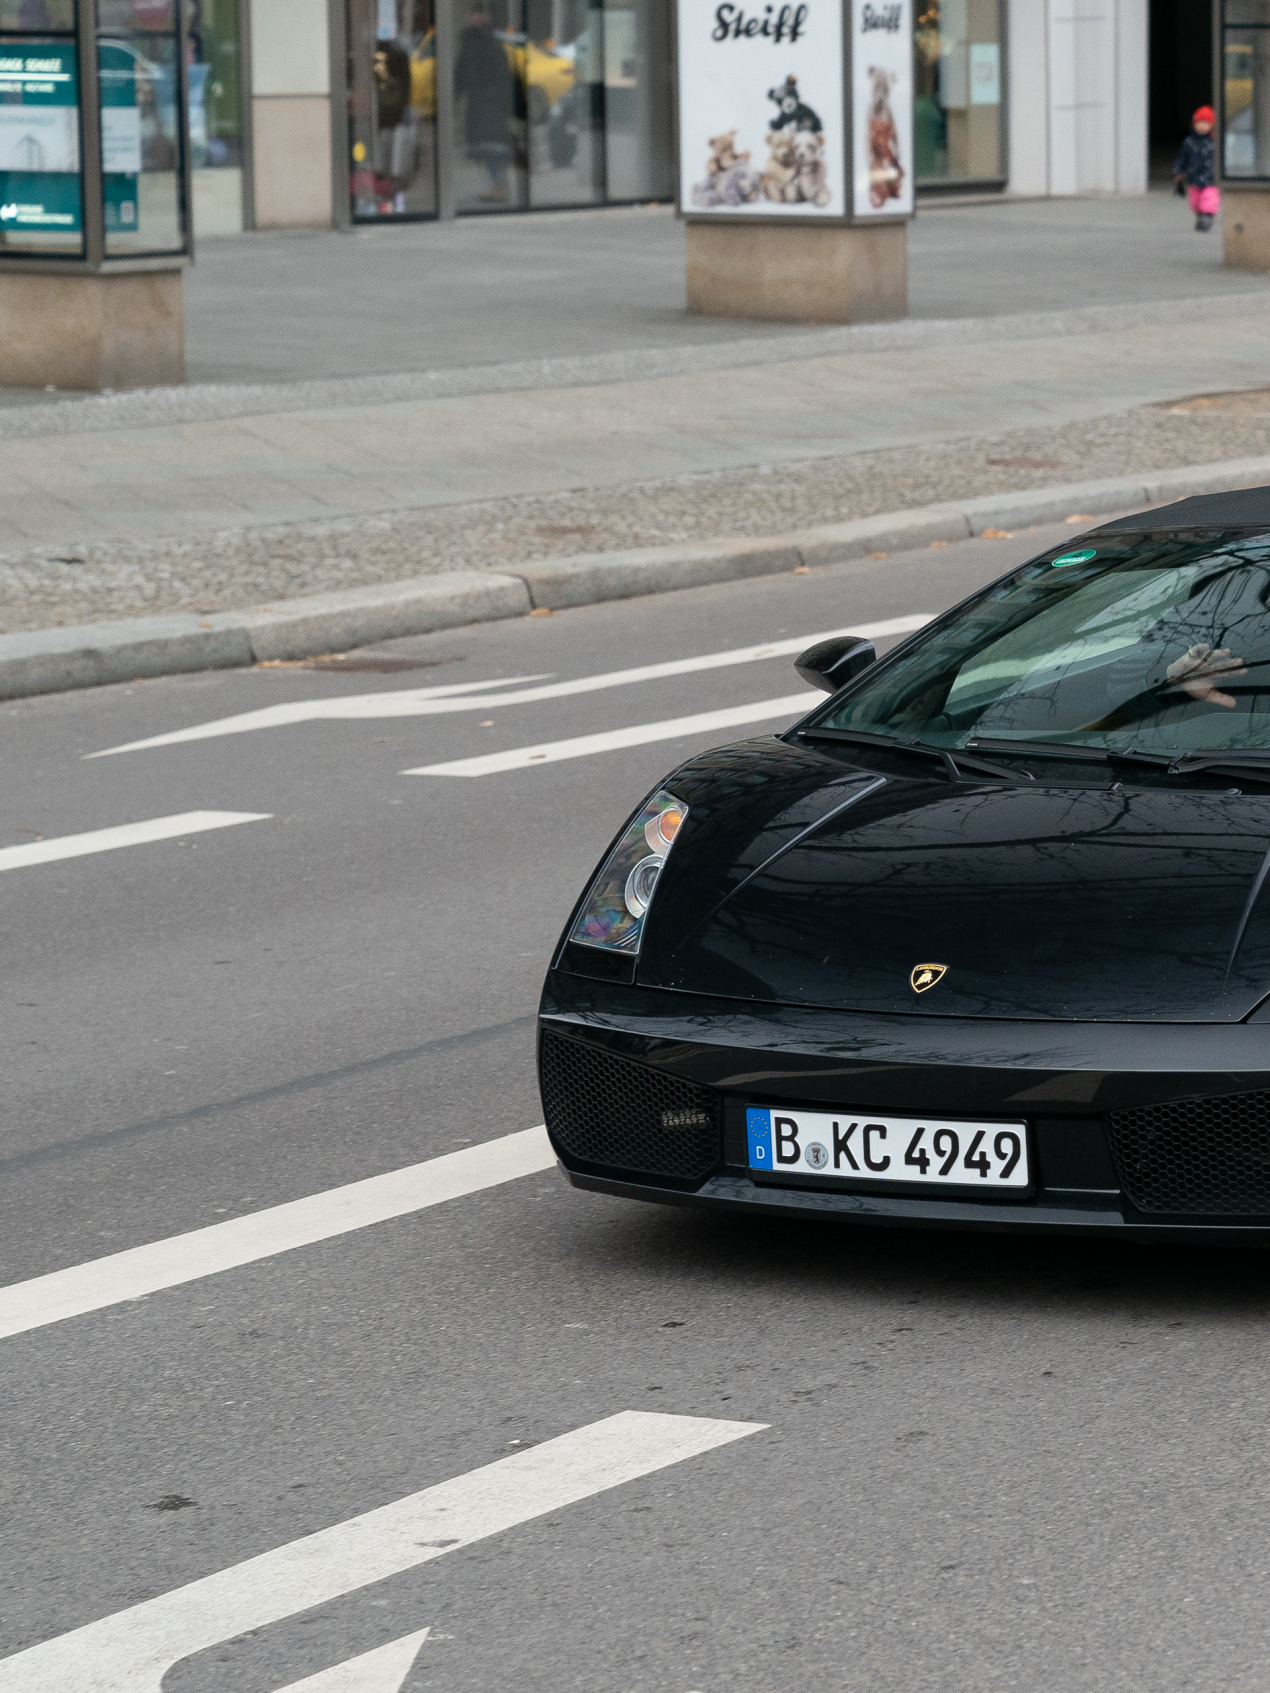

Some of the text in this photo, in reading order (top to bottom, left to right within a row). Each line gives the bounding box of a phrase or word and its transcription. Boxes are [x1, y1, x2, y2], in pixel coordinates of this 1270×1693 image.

[713, 4, 808, 44] Steiff
[861, 4, 902, 33] Steiff
[755, 1145, 766, 1161] D
[774, 1117, 801, 1165] B
[832, 1121, 891, 1172] KC
[904, 1126, 1021, 1180] 4949
